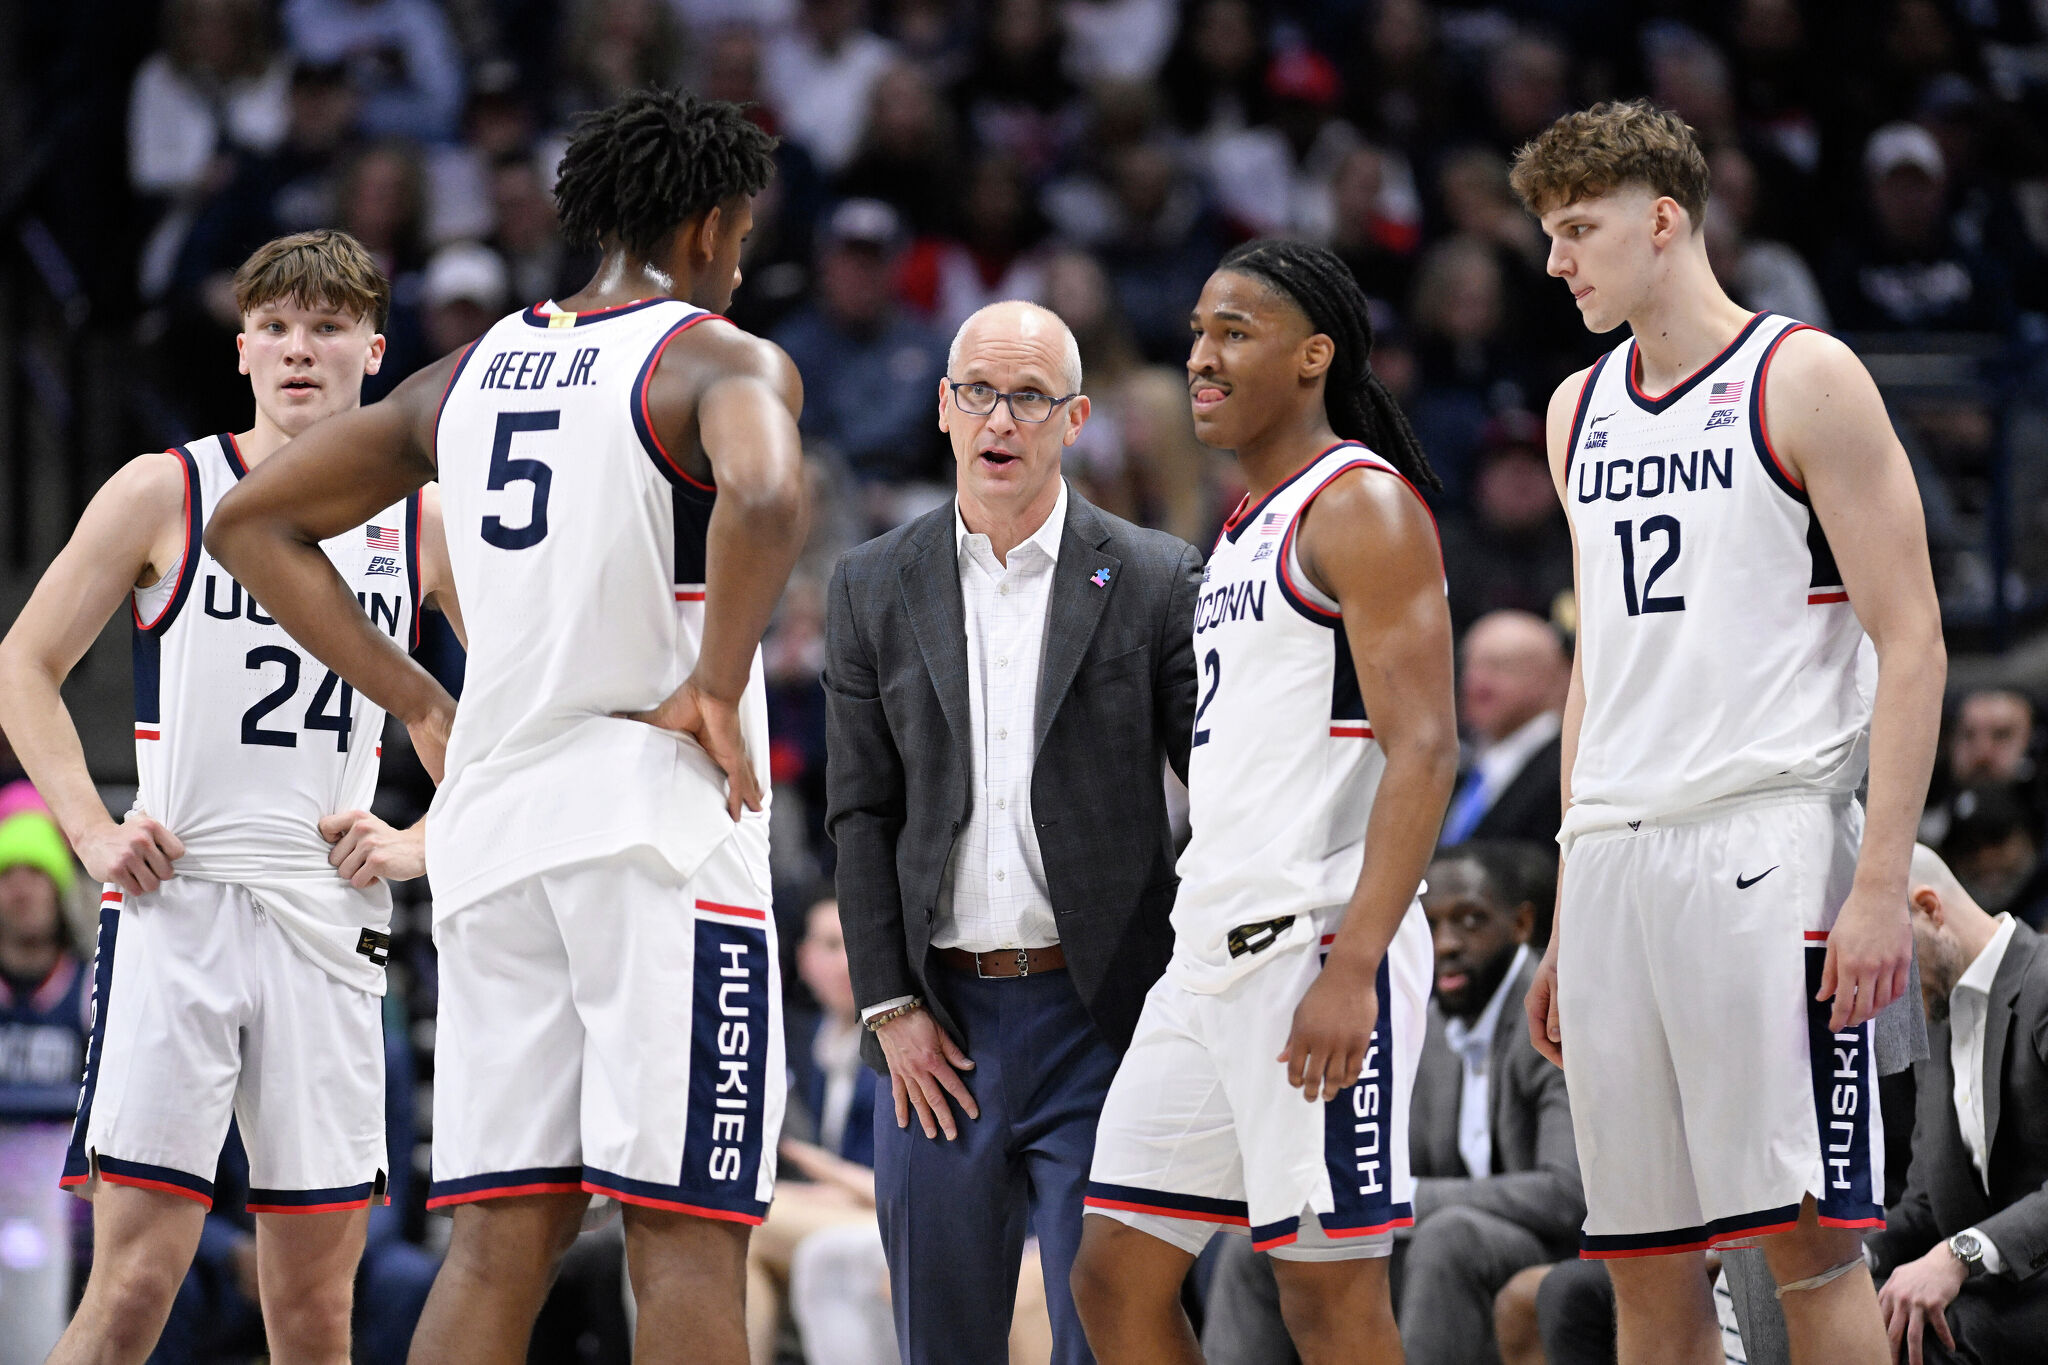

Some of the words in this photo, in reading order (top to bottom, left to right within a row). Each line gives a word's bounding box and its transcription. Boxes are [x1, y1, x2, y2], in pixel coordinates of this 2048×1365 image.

[480, 351, 557, 390] REED
[556, 348, 600, 388] JR.
[1593, 431, 1608, 440] THE
[1706, 416, 1739, 426] EAST
[1711, 408, 1735, 418] BIG
[1584, 439, 1608, 449] HANGE
[480, 409, 561, 551] 5
[1578, 447, 1734, 504] UCONN
[368, 563, 402, 574] EAST
[371, 556, 396, 566] BIG
[1614, 514, 1686, 617] 12
[241, 645, 354, 753] 24
[1193, 647, 1221, 748] 2
[708, 942, 750, 1182] HUSKIES
[1353, 1030, 1383, 1196] HUSK
[1828, 1024, 1860, 1190] HUSKI
